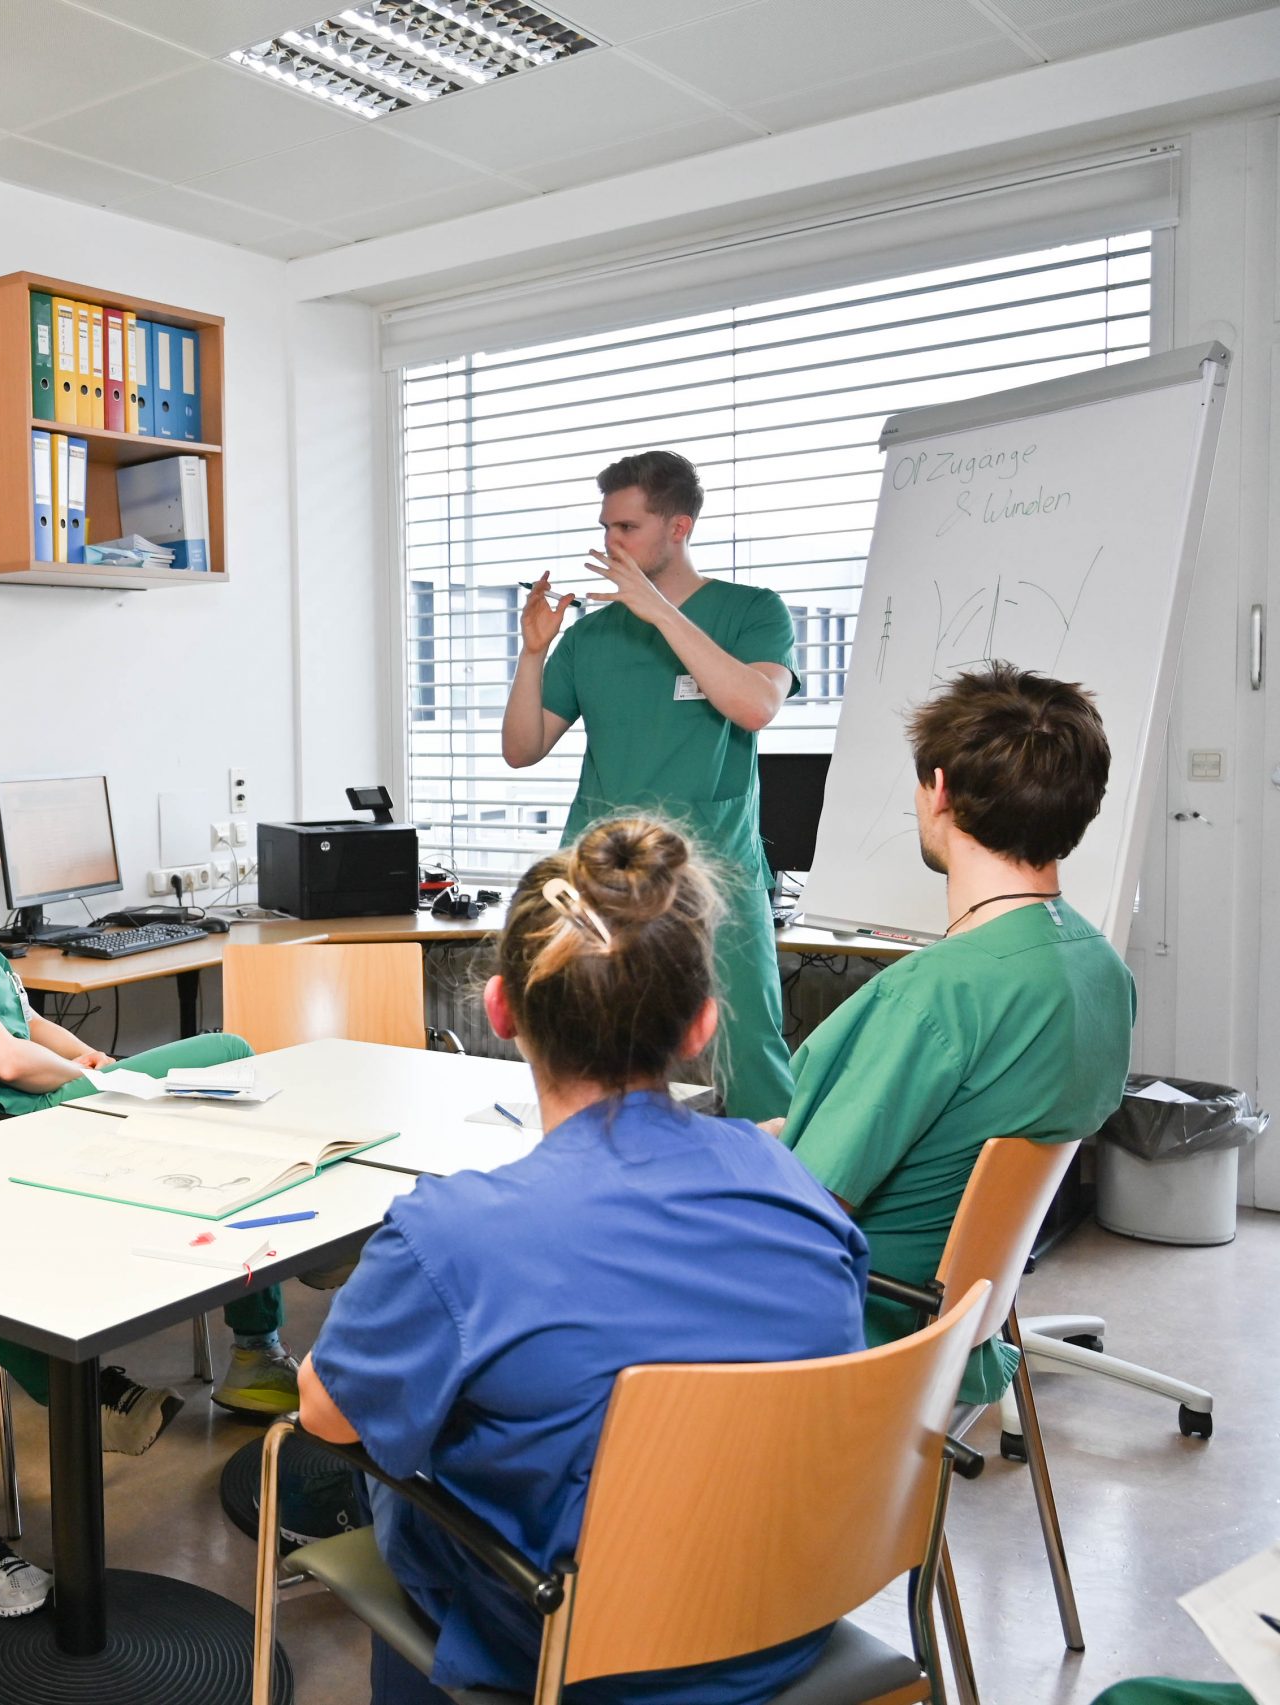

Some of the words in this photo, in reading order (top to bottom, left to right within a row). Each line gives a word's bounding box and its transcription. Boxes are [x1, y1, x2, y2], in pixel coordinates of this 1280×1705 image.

[893, 452, 927, 490] OP
[927, 444, 1037, 484] Zugänge
[983, 485, 1070, 523] Wunden
